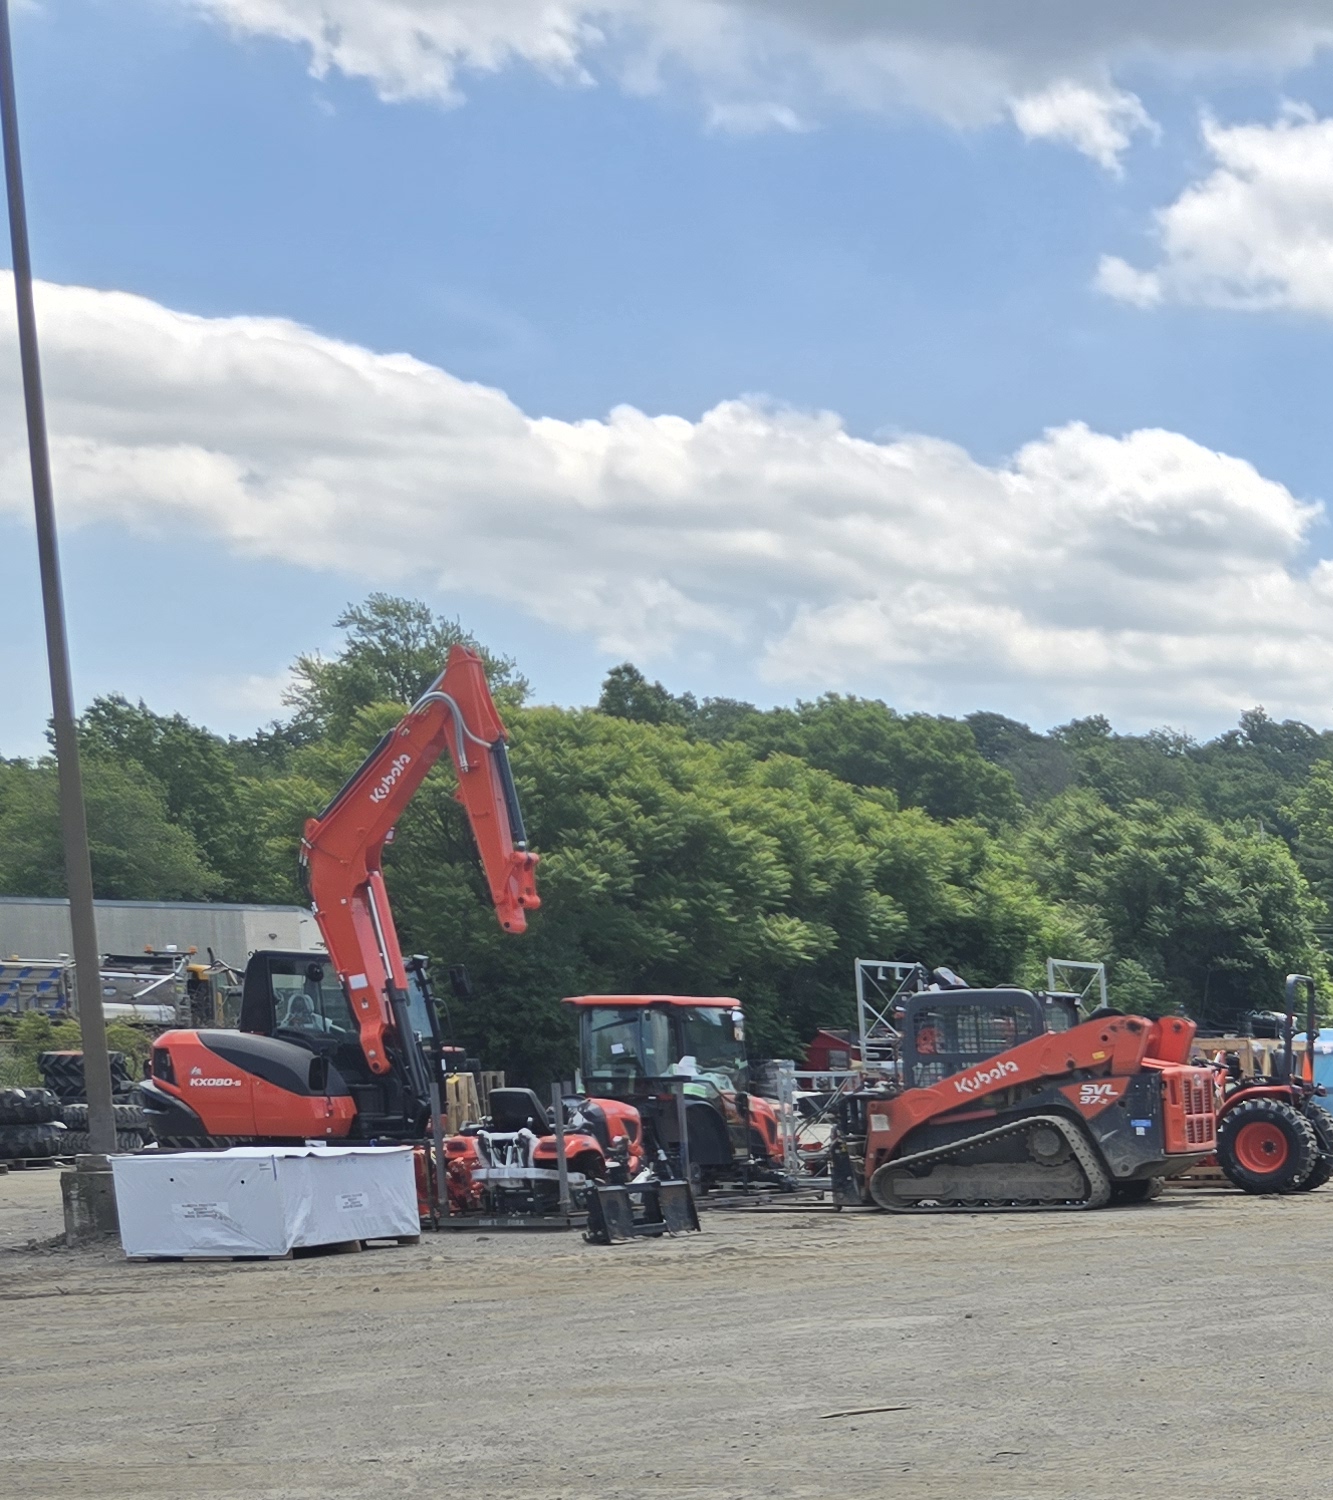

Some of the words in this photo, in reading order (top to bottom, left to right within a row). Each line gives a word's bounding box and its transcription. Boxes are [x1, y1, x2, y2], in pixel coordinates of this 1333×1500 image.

[369, 753, 411, 804] Kubota
[953, 1060, 1019, 1093] Kubota
[1079, 1083, 1119, 1096] SVL
